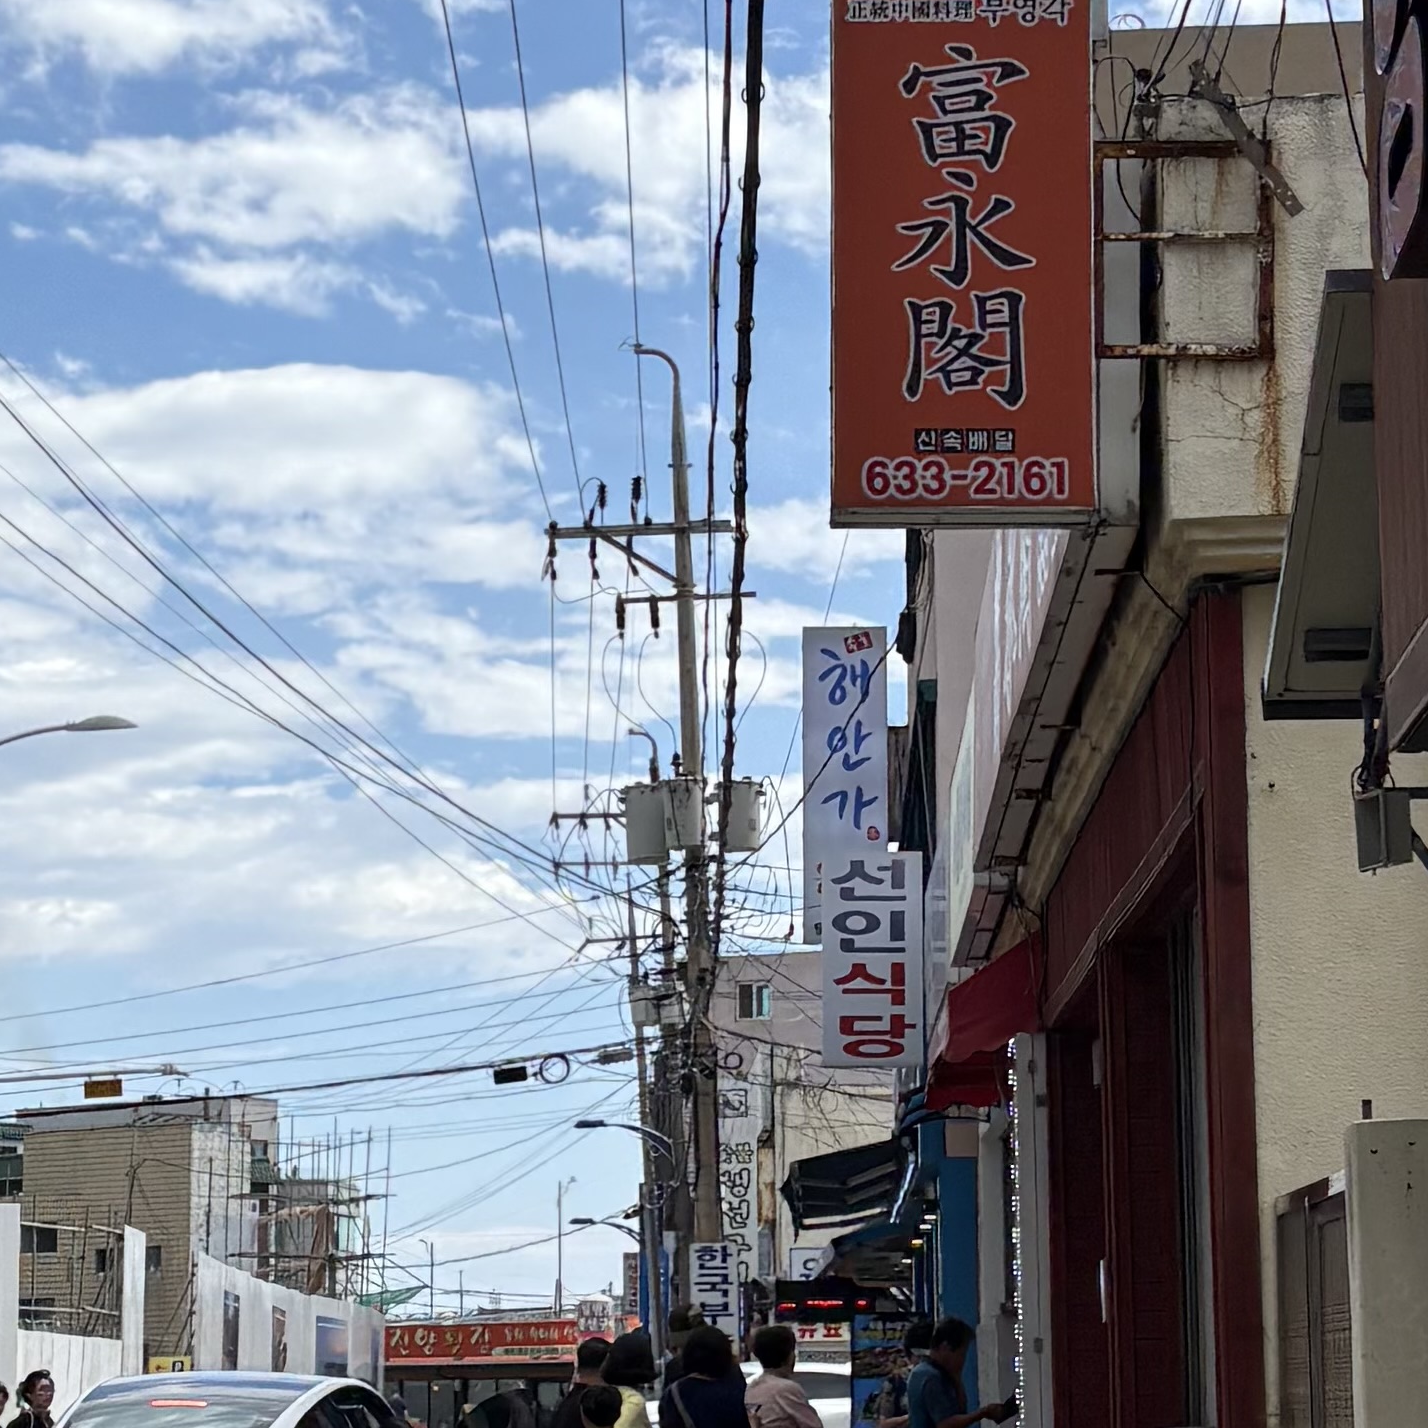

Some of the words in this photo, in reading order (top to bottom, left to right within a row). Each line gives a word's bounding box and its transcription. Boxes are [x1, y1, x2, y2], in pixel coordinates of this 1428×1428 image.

[891, 44, 1037, 410] 富永閣
[862, 456, 1069, 500] 633-2161
[914, 429, 1015, 453] 신속배달
[819, 648, 879, 830] 해안가
[830, 859, 917, 1059] 선인식당
[693, 1245, 735, 1326] 한국부
